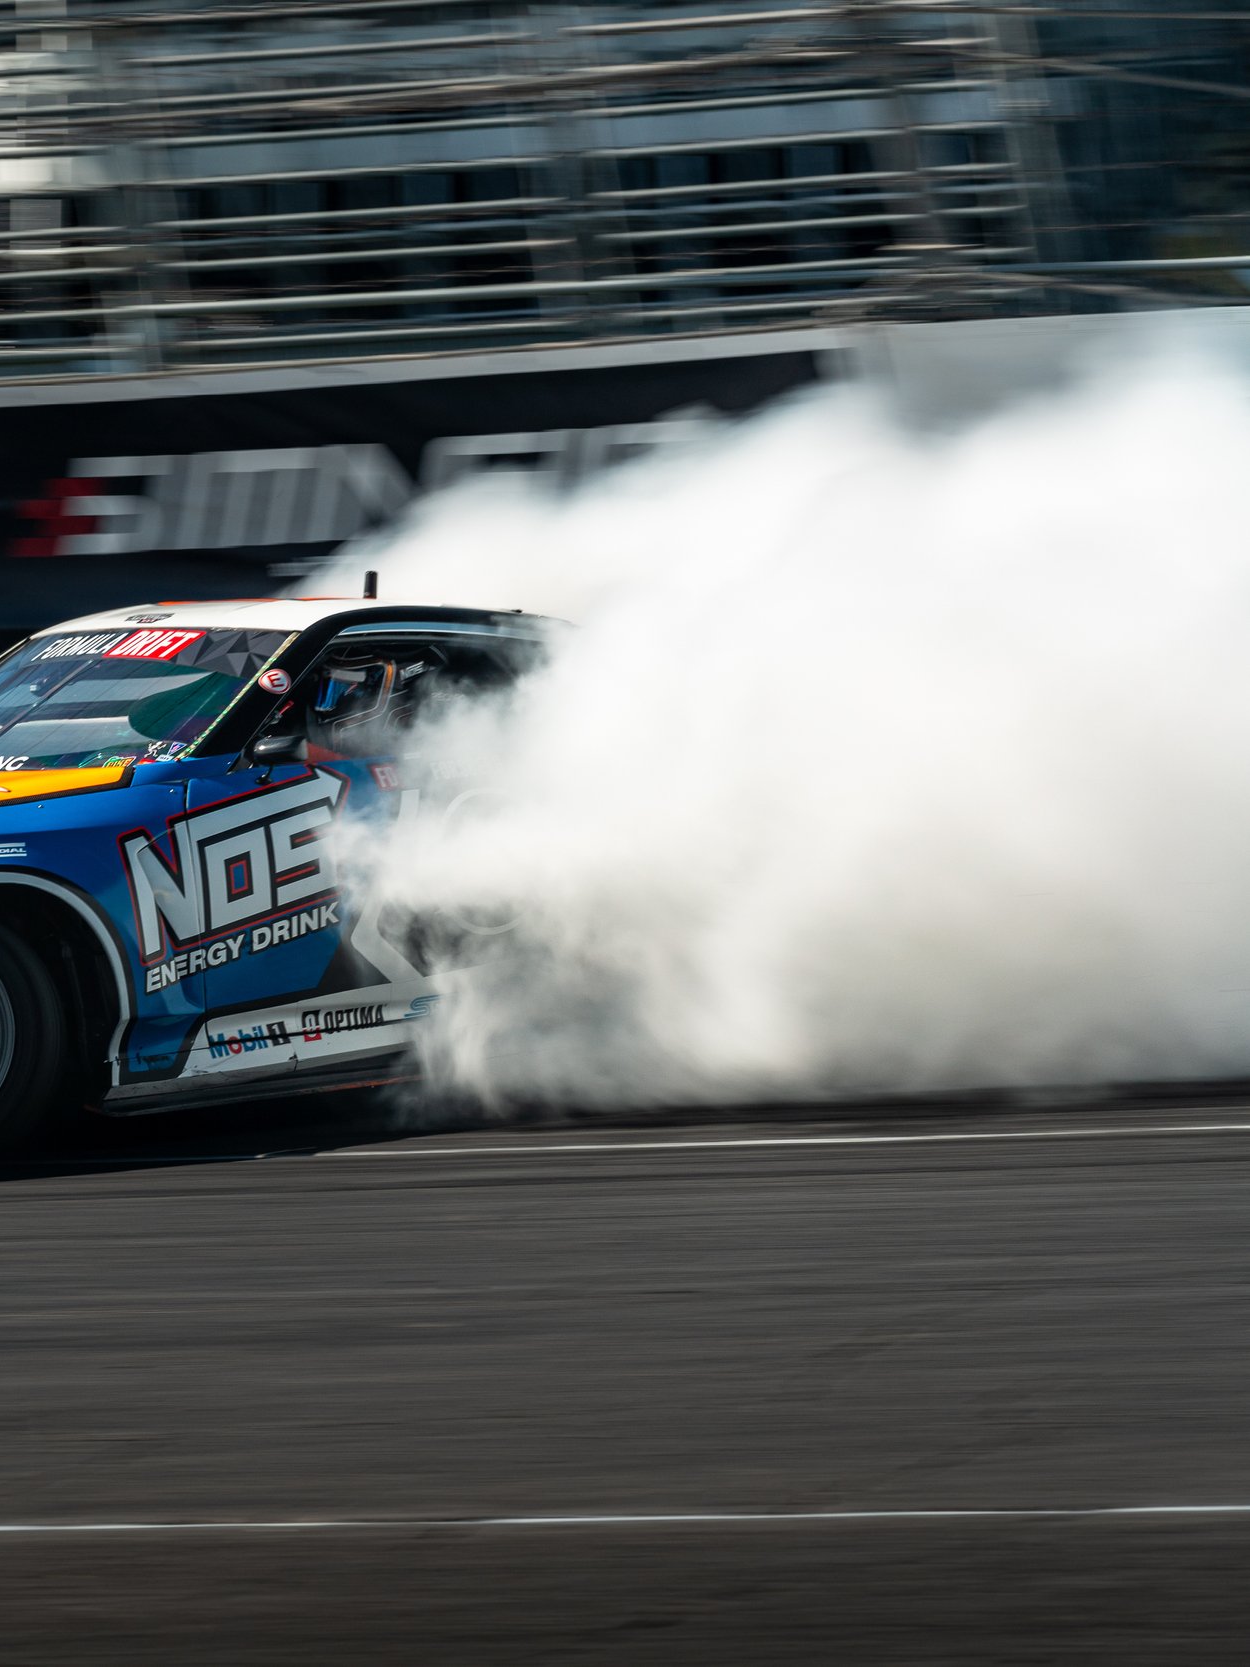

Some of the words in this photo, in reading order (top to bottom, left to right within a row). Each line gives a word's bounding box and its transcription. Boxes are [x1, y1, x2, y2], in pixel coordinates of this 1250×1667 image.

[31, 633, 129, 662] FORMULA
[108, 630, 200, 659] DRIFT
[267, 672, 286, 690] E
[122, 766, 345, 958] NOS
[145, 933, 246, 993] ENERGY
[252, 901, 340, 952] DRINK
[323, 1004, 385, 1034] OPTIMA
[209, 1025, 269, 1059] Mobil
[268, 1022, 288, 1046] 1
